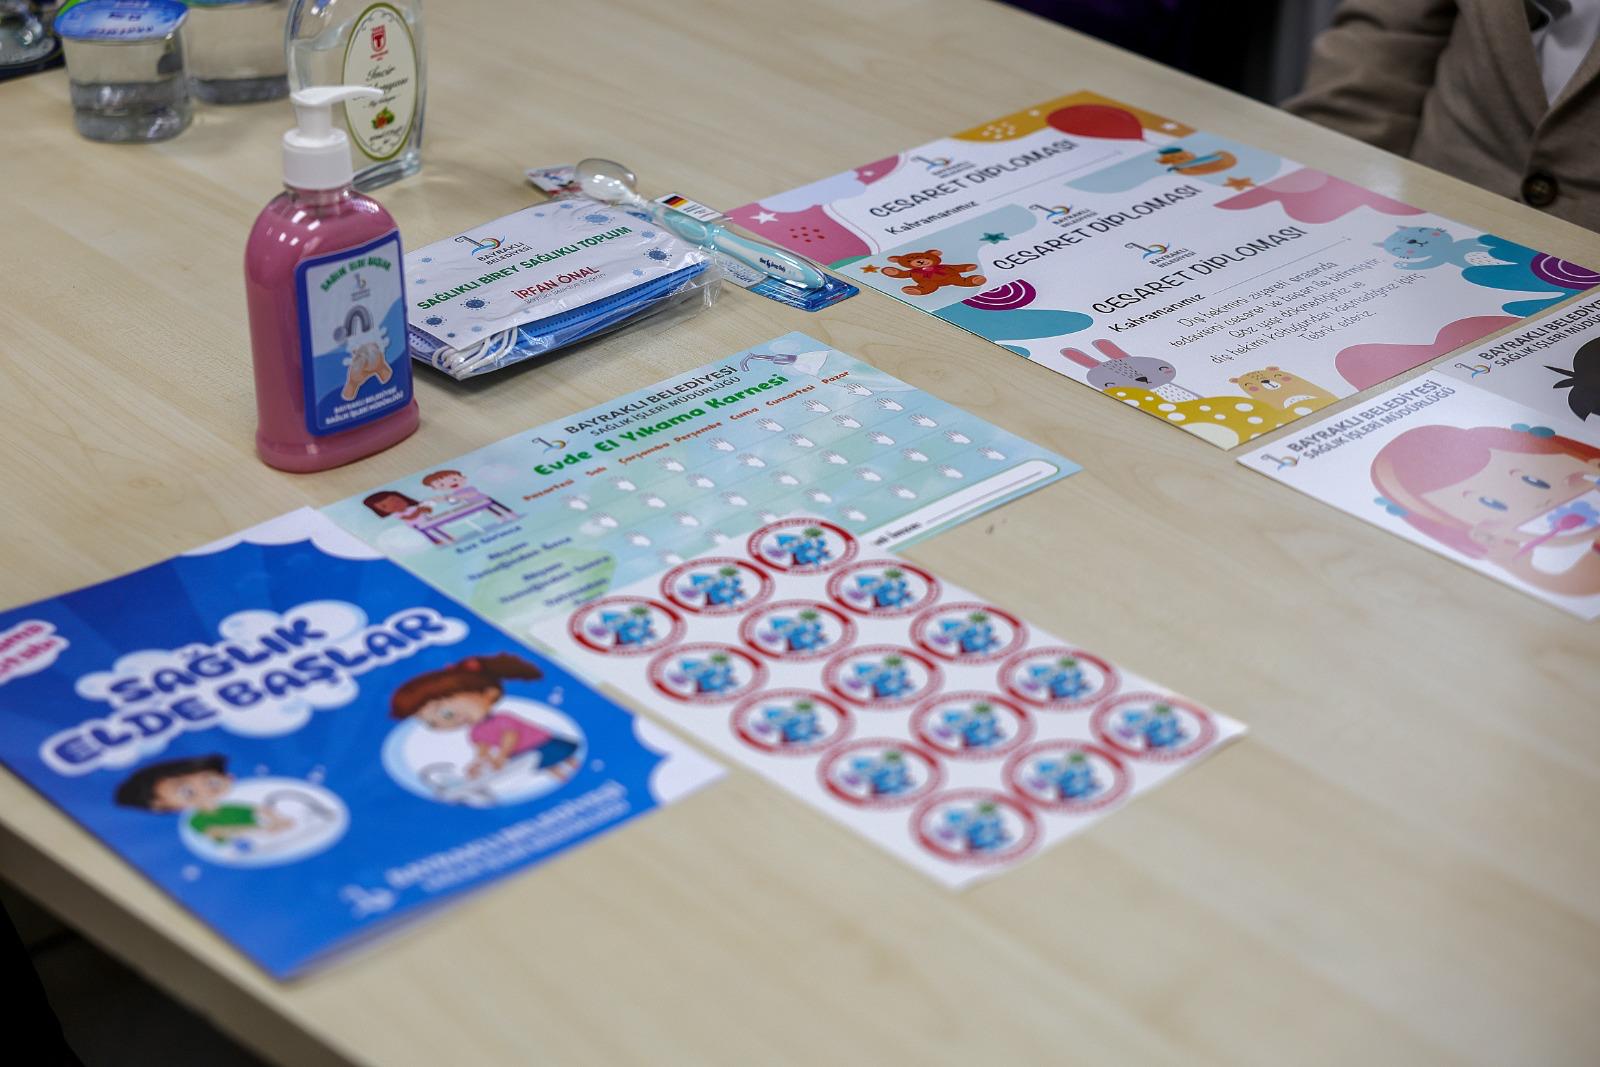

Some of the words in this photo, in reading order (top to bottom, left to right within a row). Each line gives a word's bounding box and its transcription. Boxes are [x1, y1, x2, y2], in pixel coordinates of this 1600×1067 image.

[869, 178, 970, 218] CESARET
[965, 138, 1080, 184] DİPLOMASI
[477, 242, 524, 261] BAYRAKLI
[884, 200, 980, 236] Kahramanımız
[993, 228, 1092, 270] CESARET
[1087, 184, 1203, 233] DİPLOMASI
[417, 280, 482, 310] SAĞLIKLI
[478, 265, 520, 286] BİREY
[520, 246, 582, 269] SAĞLIKLI
[577, 226, 633, 249] TOPLUM
[511, 280, 559, 300] İRFAN
[556, 266, 600, 284] ÖNAL
[1092, 271, 1195, 315] CESARET
[1190, 226, 1308, 276] DİPLOMASI
[1149, 247, 1189, 264] BAYRAKLI
[1108, 293, 1206, 334] Kahramanımız
[1224, 305, 1266, 325] cesaret
[1265, 299, 1282, 308] ve
[1478, 327, 1550, 360] BAYRAKLI
[1494, 346, 1538, 367] SAĞLIK
[534, 451, 593, 476] Evde
[594, 438, 621, 452] El
[619, 408, 706, 442] Yıkama
[704, 373, 789, 410] Karnesi
[564, 400, 649, 435] BAYRAKLI
[646, 365, 738, 404] BELEDİYESİ
[590, 417, 635, 437] SAĞLIK
[632, 404, 671, 422] İŞLERİ
[670, 376, 742, 408] MÜDÜRLÜĞÜ
[673, 421, 723, 443] Perşembe
[729, 406, 760, 421] Cuma
[765, 384, 816, 407] Cumartesi
[821, 370, 849, 385] Pazar
[1287, 416, 1365, 453] BAYRAKLI
[1360, 379, 1442, 421] BELEDİYESİ
[1303, 432, 1349, 460] SAĞLIK
[1346, 418, 1384, 442] İŞLERİ
[1380, 387, 1457, 424] MÜDÜRLÜĞÜ
[53, 697, 217, 765] ELDE
[219, 612, 446, 708] BAŞLAR
[110, 616, 325, 703] SAĞLIK
